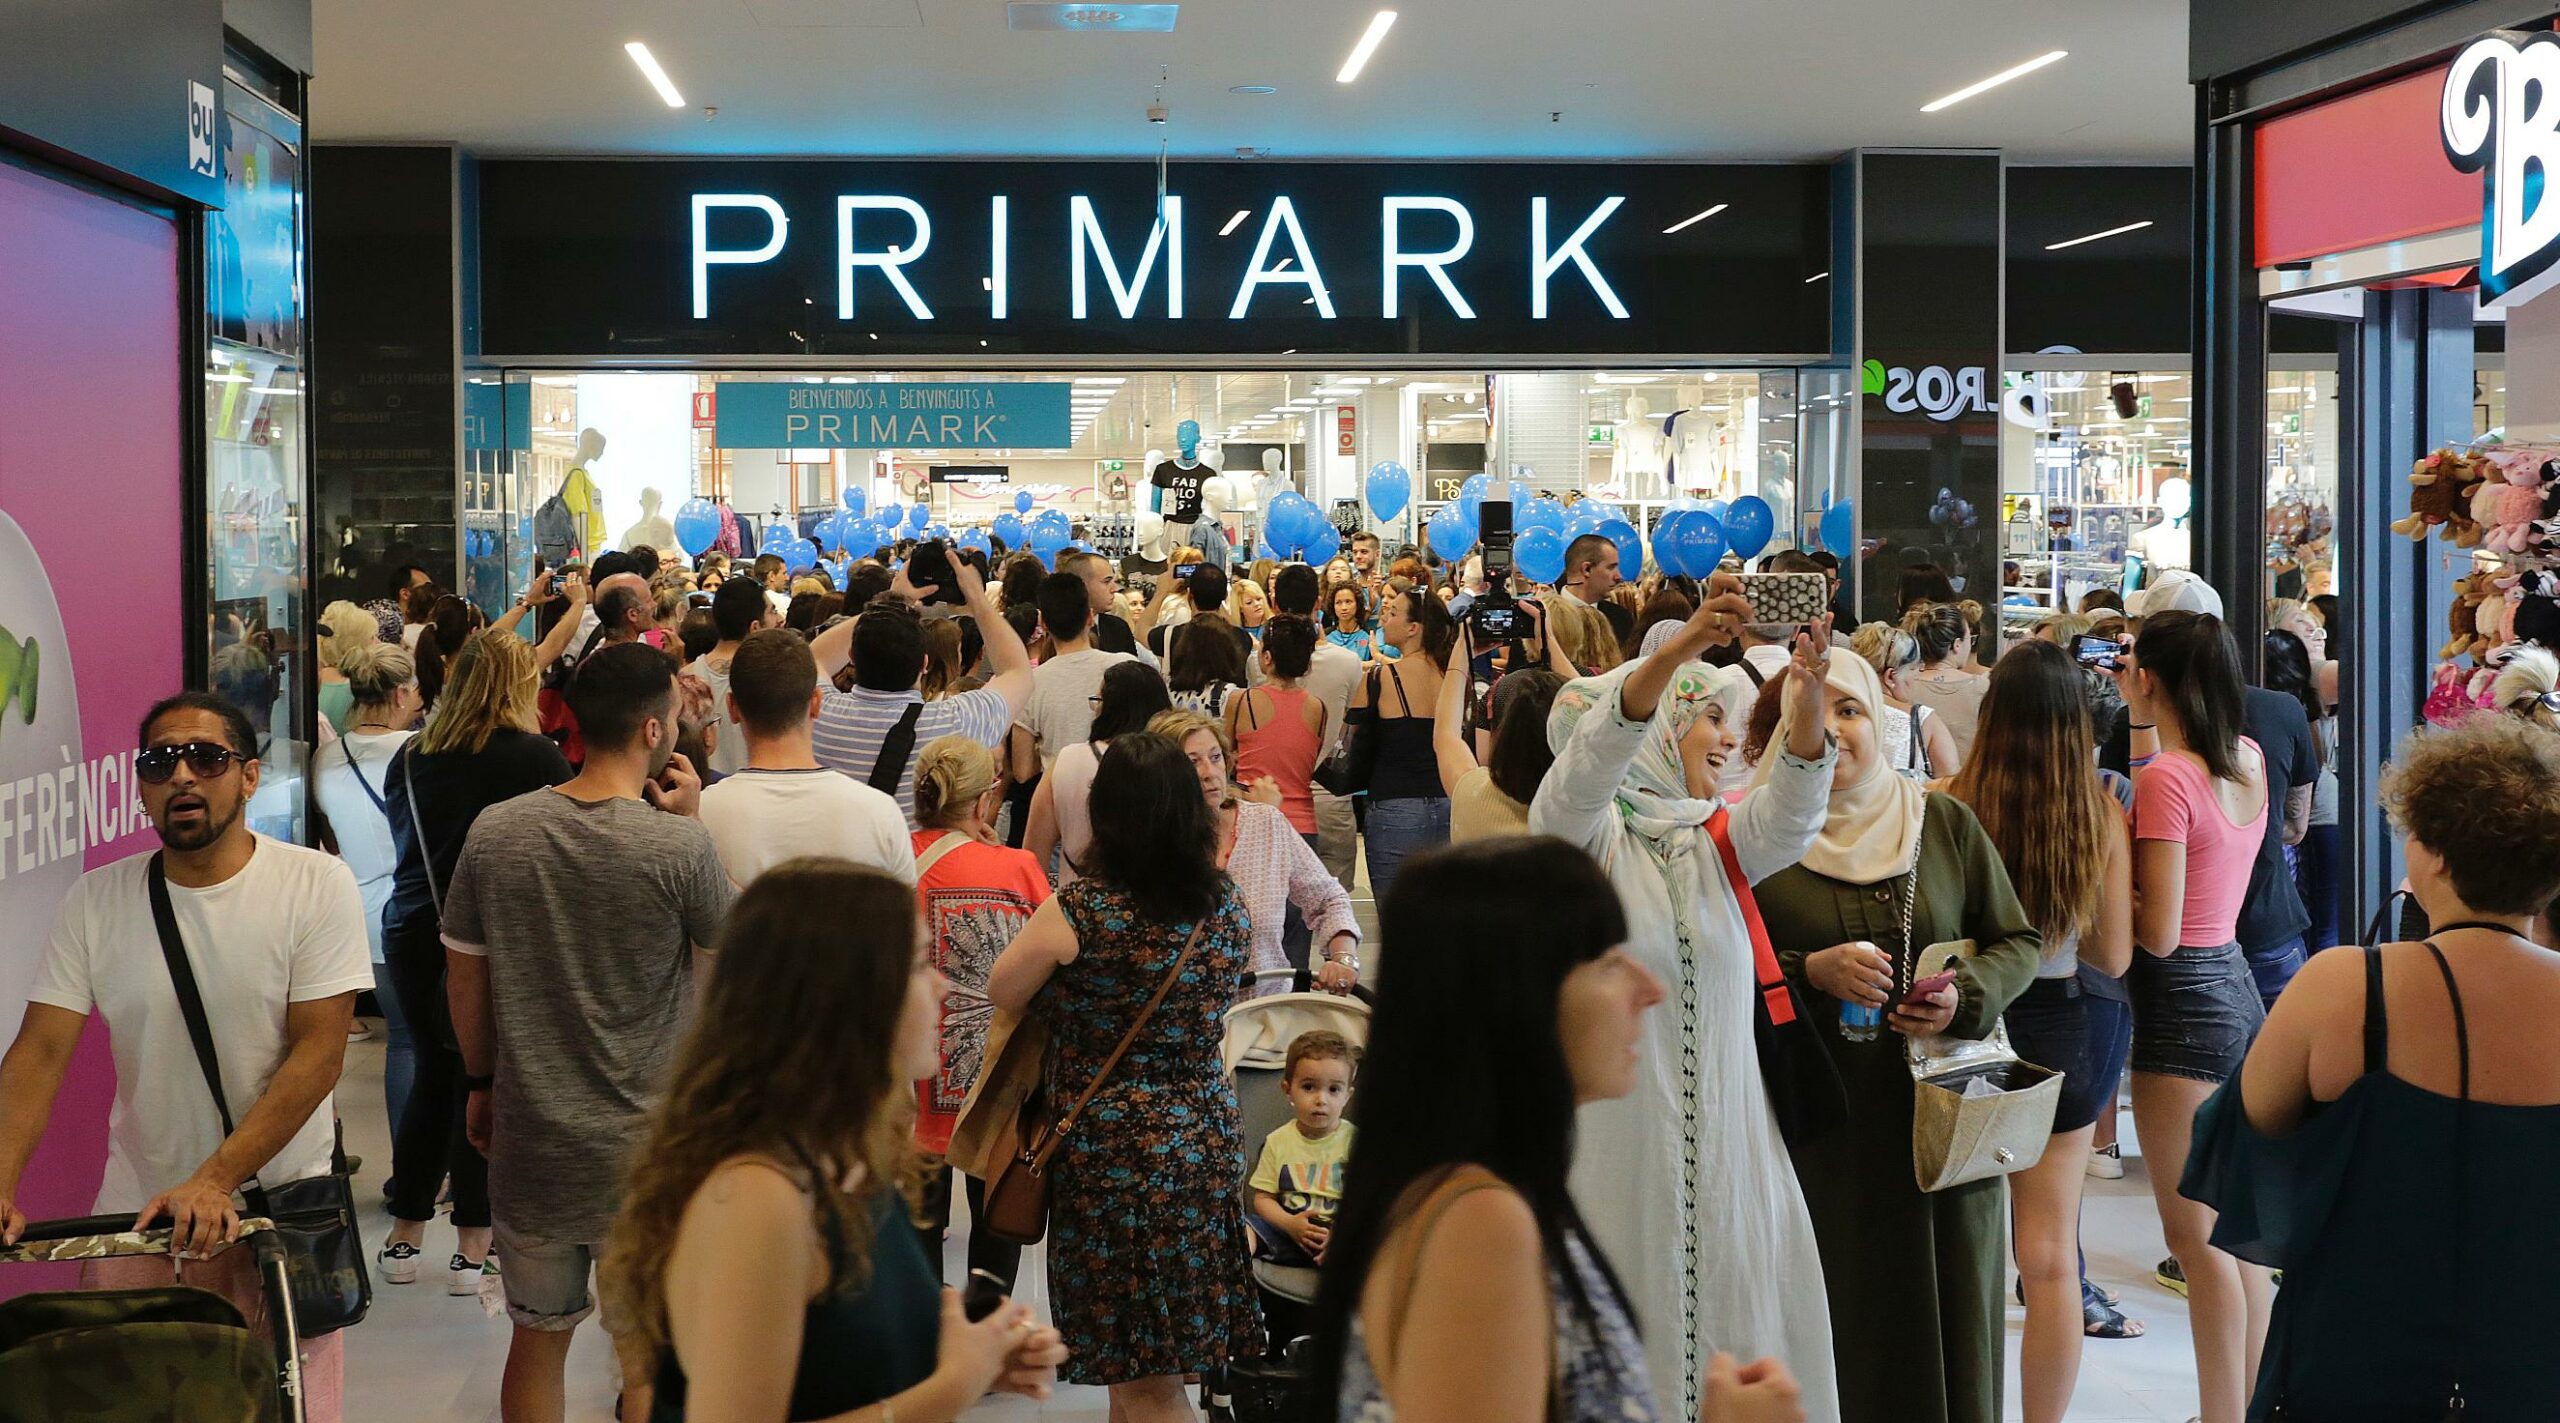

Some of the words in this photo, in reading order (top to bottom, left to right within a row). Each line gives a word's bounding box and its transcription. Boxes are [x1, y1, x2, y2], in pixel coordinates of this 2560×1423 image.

[190, 80, 215, 176] by
[690, 193, 1632, 320] PRIMARK
[789, 388, 873, 410] BIENVENIDOS
[879, 389, 888, 409] A
[899, 388, 980, 410] BENVINGUTS
[986, 389, 995, 409] A
[787, 414, 998, 443] PRIMARK
[1171, 477, 1198, 488] FAB
[1434, 478, 1461, 500] PS
[0, 745, 155, 881] FERÈNCIA
